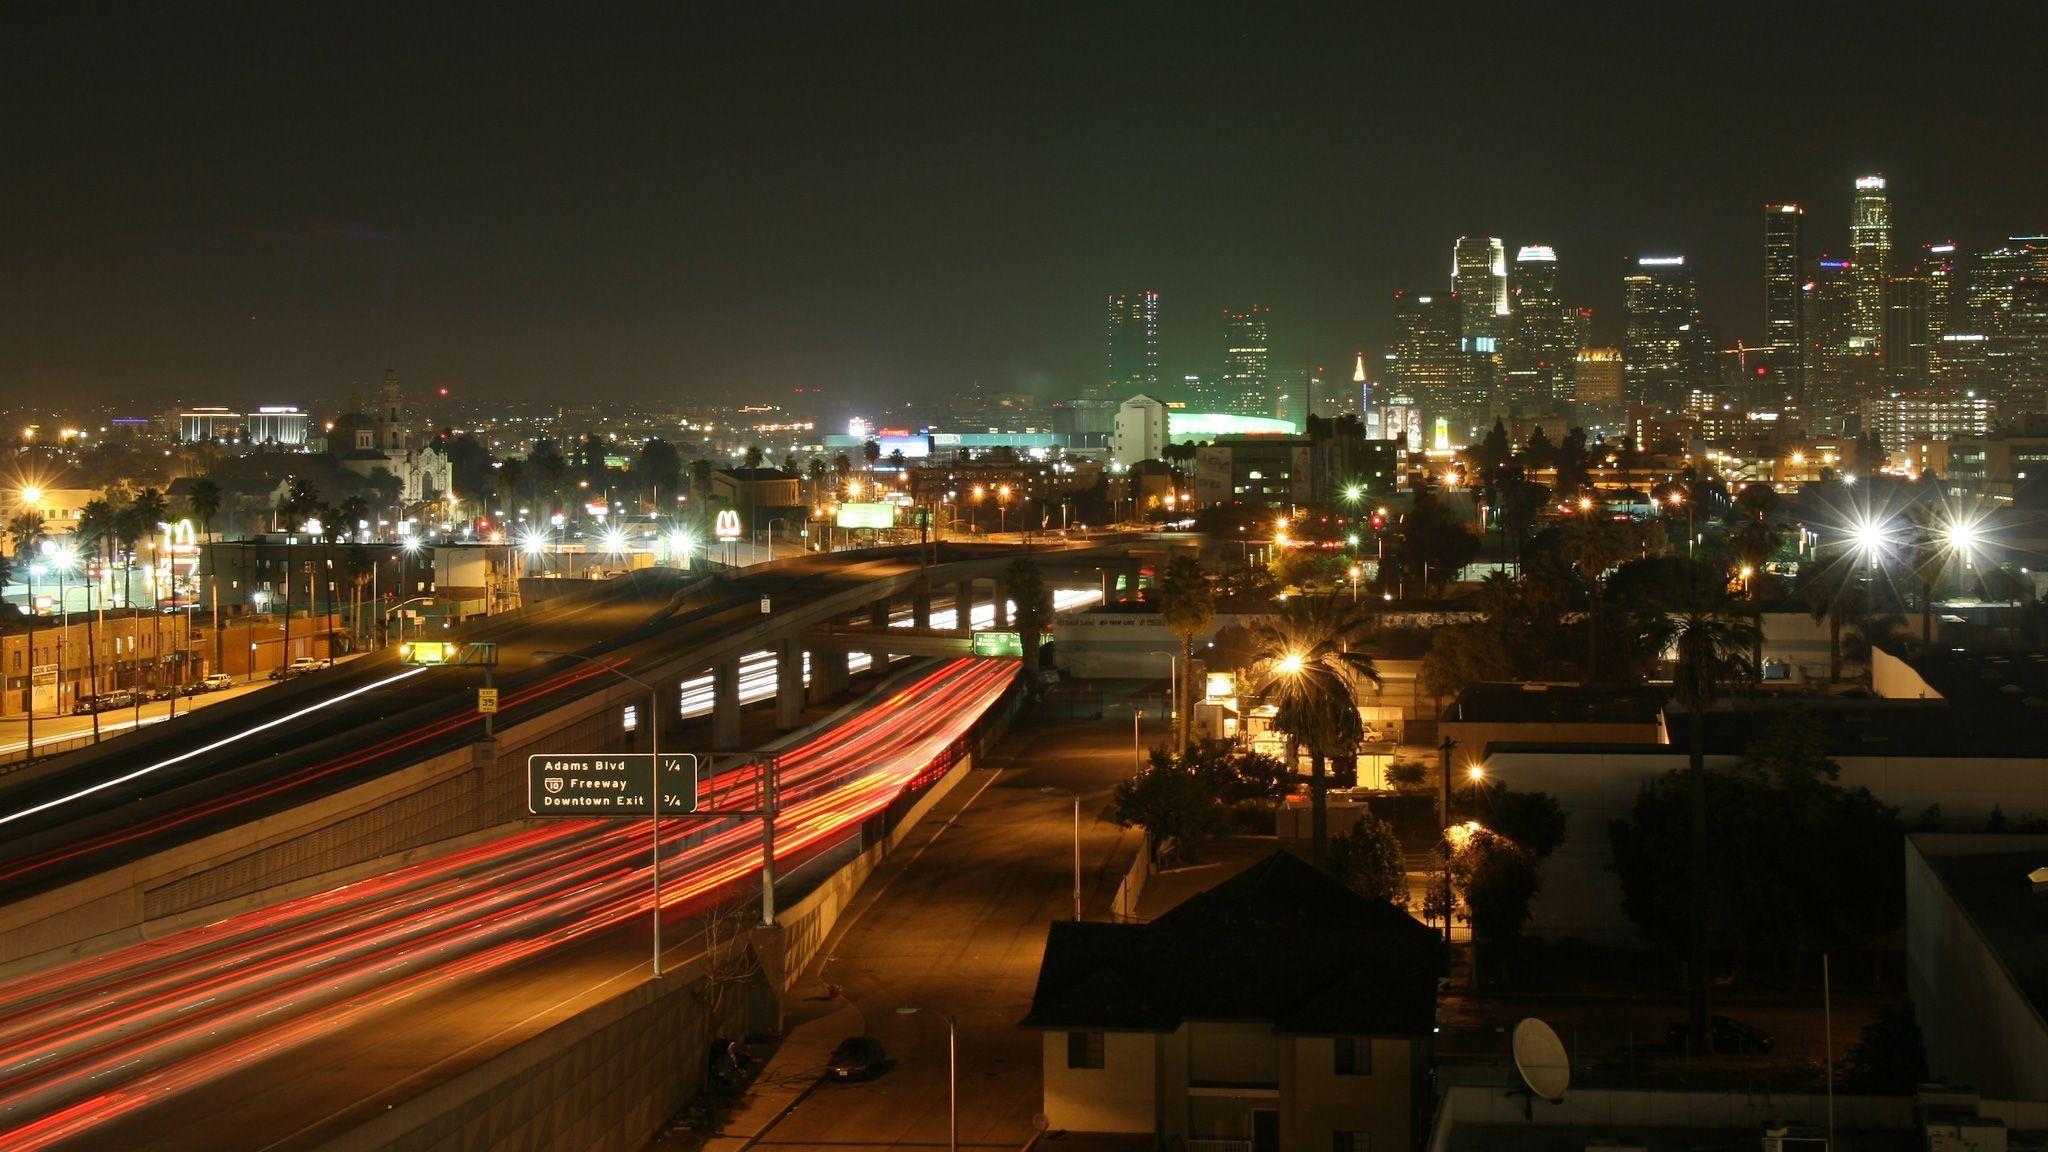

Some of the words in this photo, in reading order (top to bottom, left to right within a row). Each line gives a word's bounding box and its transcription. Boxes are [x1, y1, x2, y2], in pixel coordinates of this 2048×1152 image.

[482, 698, 494, 707] 35
[544, 761, 589, 771] Adams
[595, 760, 626, 771] Blvd
[549, 781, 559, 789] 10
[570, 778, 627, 792] Freeway
[544, 796, 610, 806] Downtown
[616, 796, 644, 806] Exit
